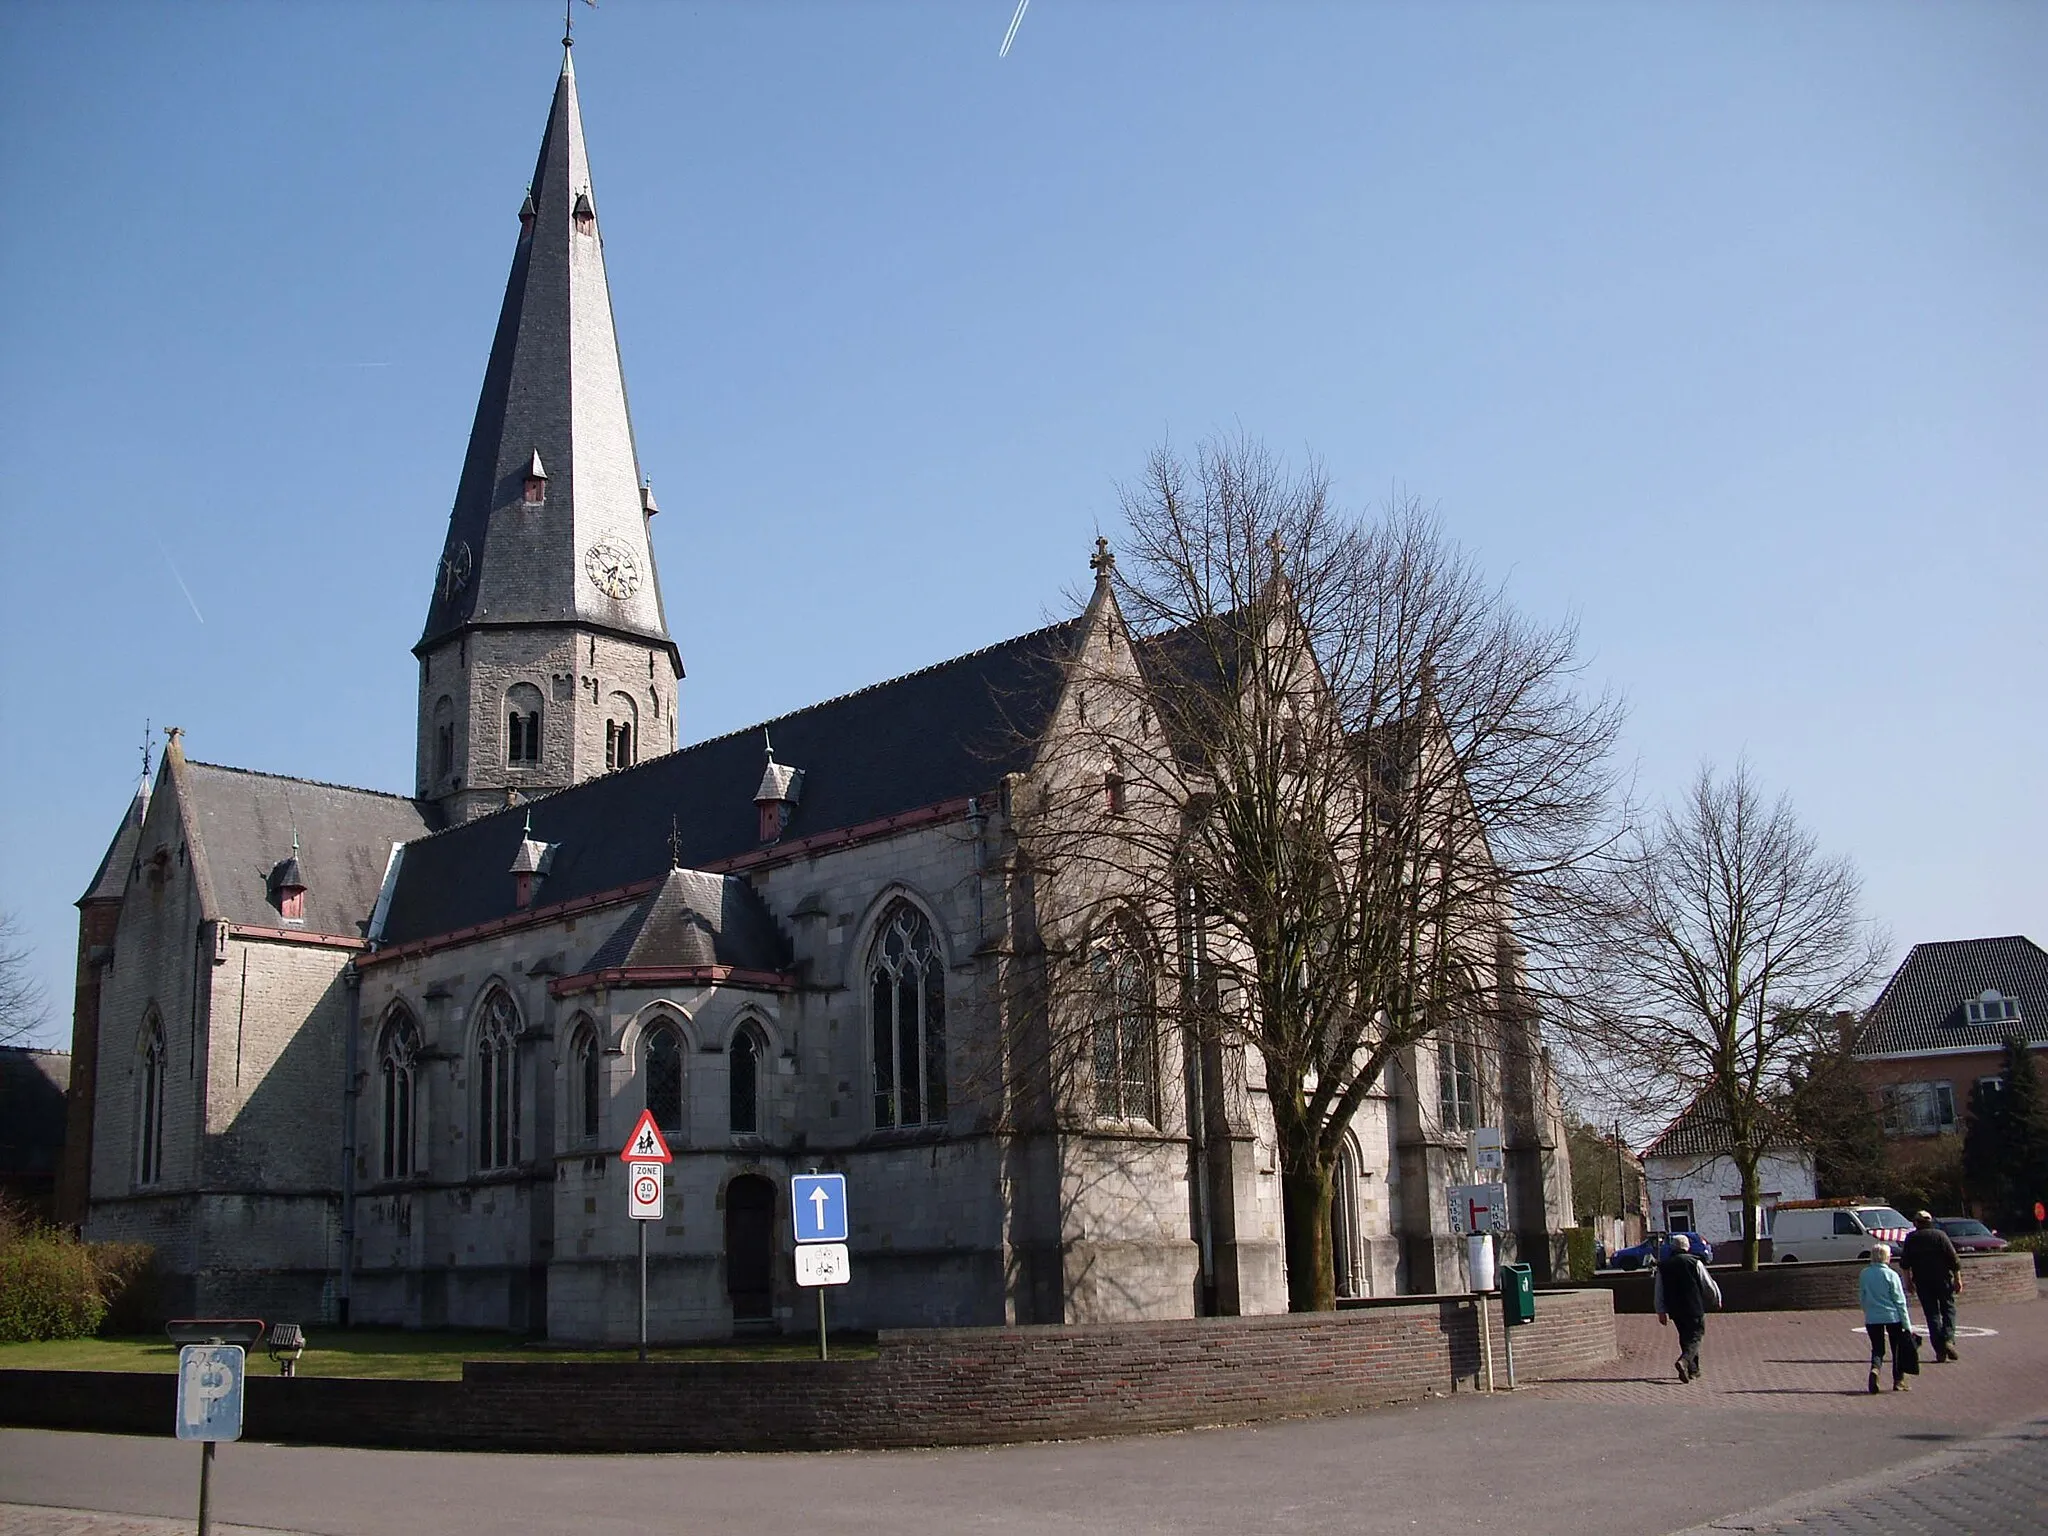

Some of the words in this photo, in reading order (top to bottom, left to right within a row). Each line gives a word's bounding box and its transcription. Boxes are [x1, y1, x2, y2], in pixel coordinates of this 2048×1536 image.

[637, 1166, 658, 1175] ZONE
[640, 1183, 652, 1192] 30
[1454, 1223, 1461, 1233] 6
[185, 1361, 233, 1425] P
